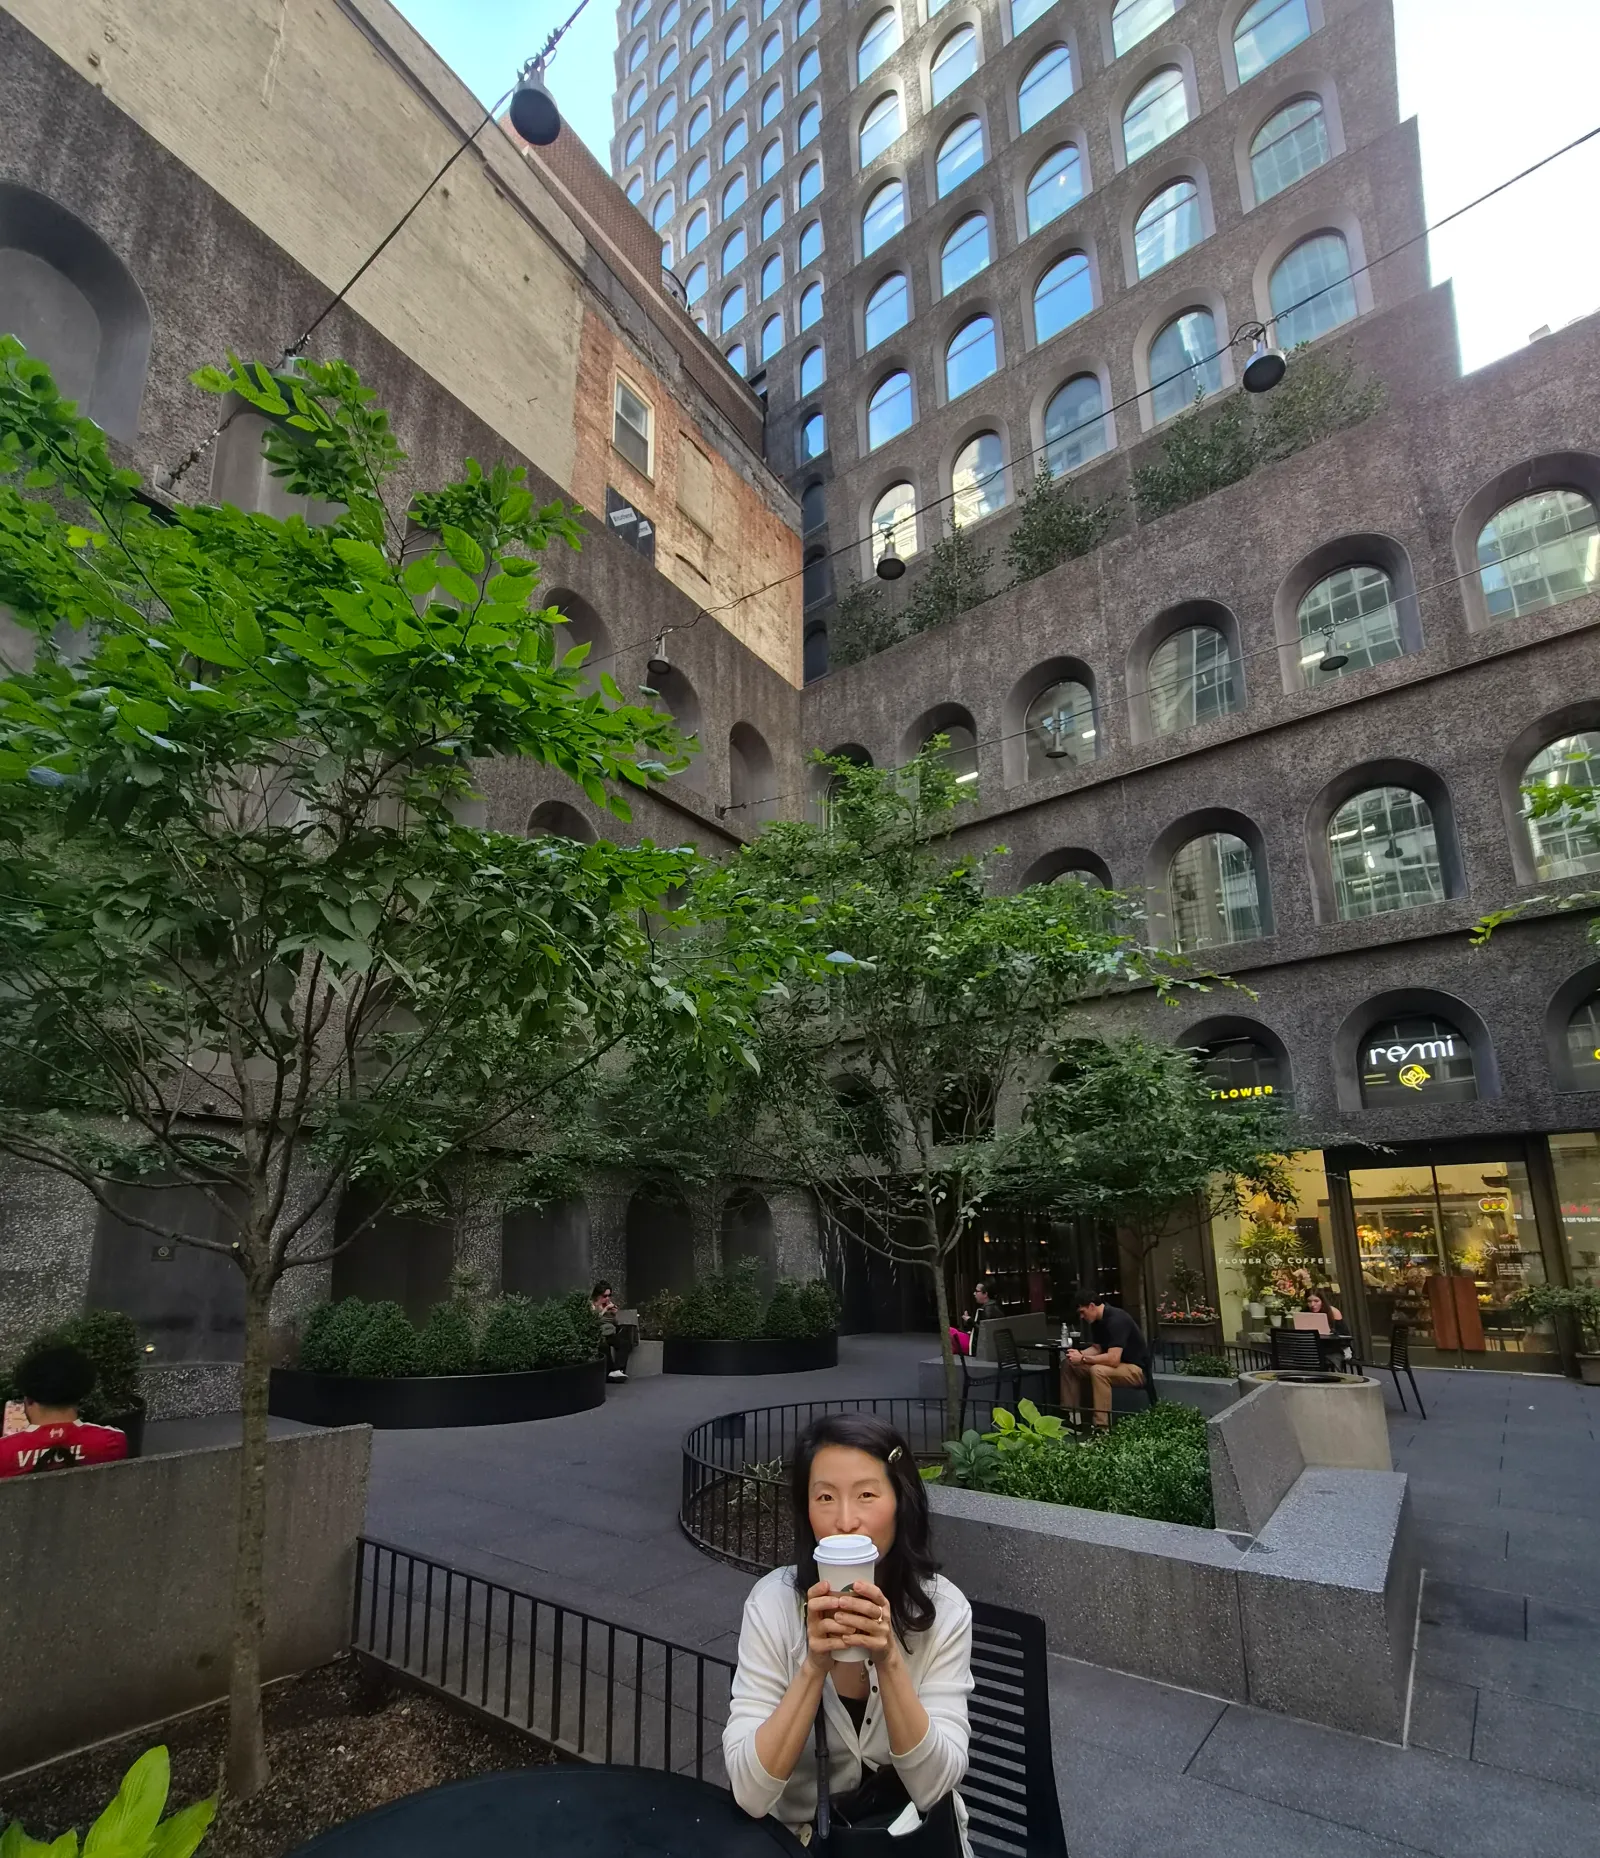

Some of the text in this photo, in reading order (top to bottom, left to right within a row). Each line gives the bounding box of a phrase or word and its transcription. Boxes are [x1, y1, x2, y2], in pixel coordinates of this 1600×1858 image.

[1370, 1035, 1454, 1065] remi
[1211, 1085, 1273, 1100] FLOWER
[1218, 1256, 1332, 1265] FLOWER COFFEE
